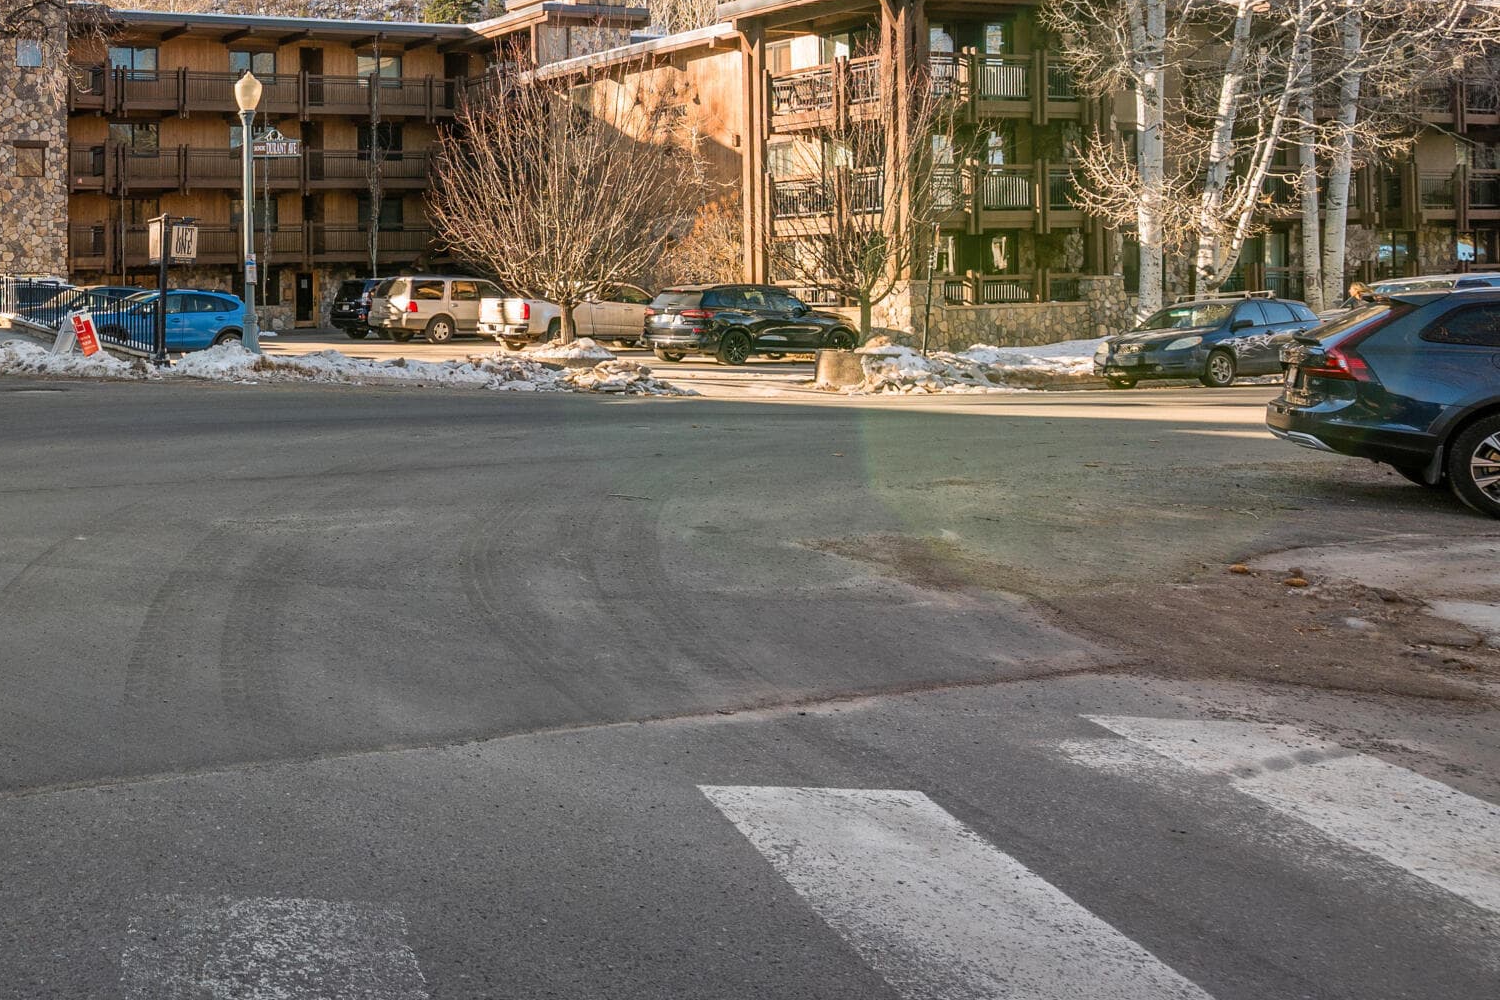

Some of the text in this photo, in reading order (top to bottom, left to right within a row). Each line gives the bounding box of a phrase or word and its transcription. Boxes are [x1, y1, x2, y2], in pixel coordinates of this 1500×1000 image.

[266, 142, 287, 155] DURANT
[176, 226, 195, 242] LIFT
[175, 239, 193, 255] ONE
